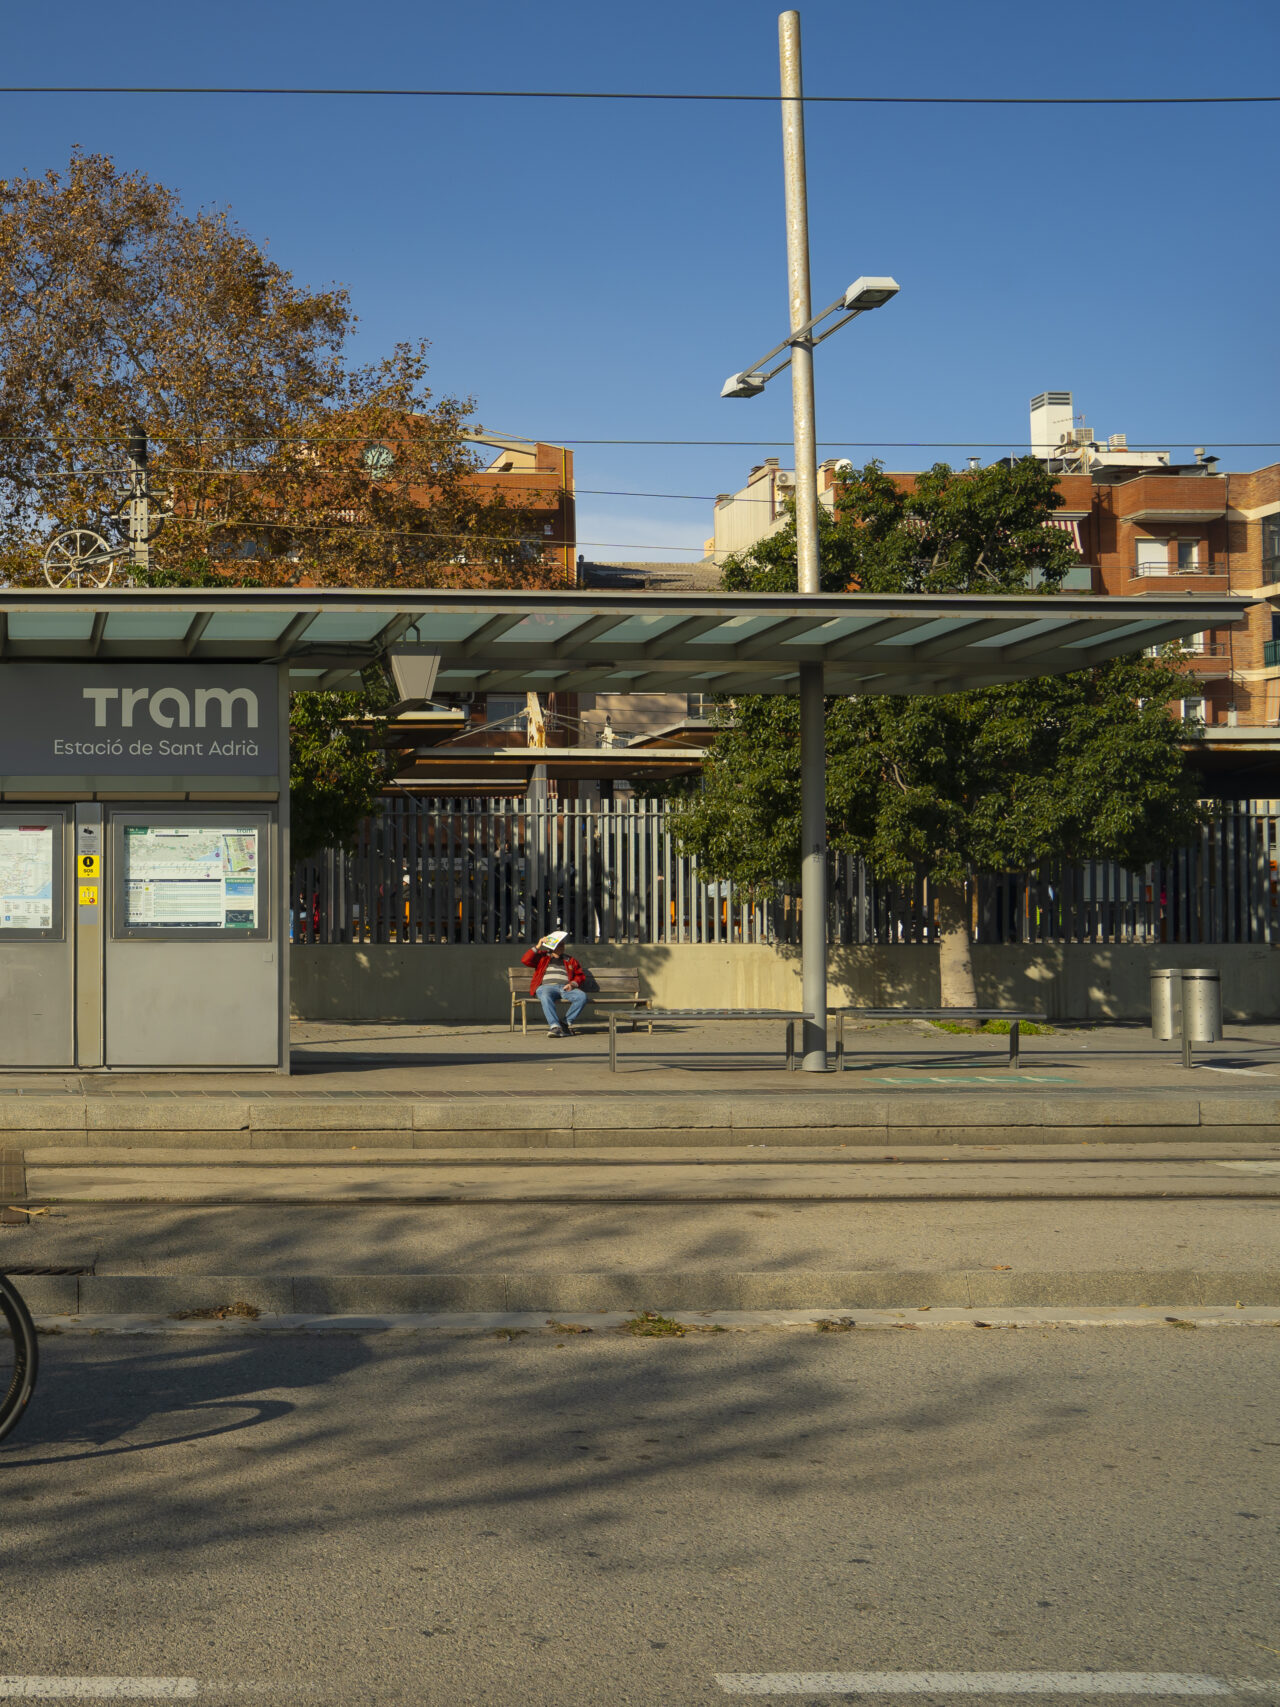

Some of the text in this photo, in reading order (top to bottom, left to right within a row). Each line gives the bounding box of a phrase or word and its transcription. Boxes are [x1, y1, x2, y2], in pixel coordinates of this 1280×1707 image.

[54, 739, 259, 756] Estació de Sant Adrià
